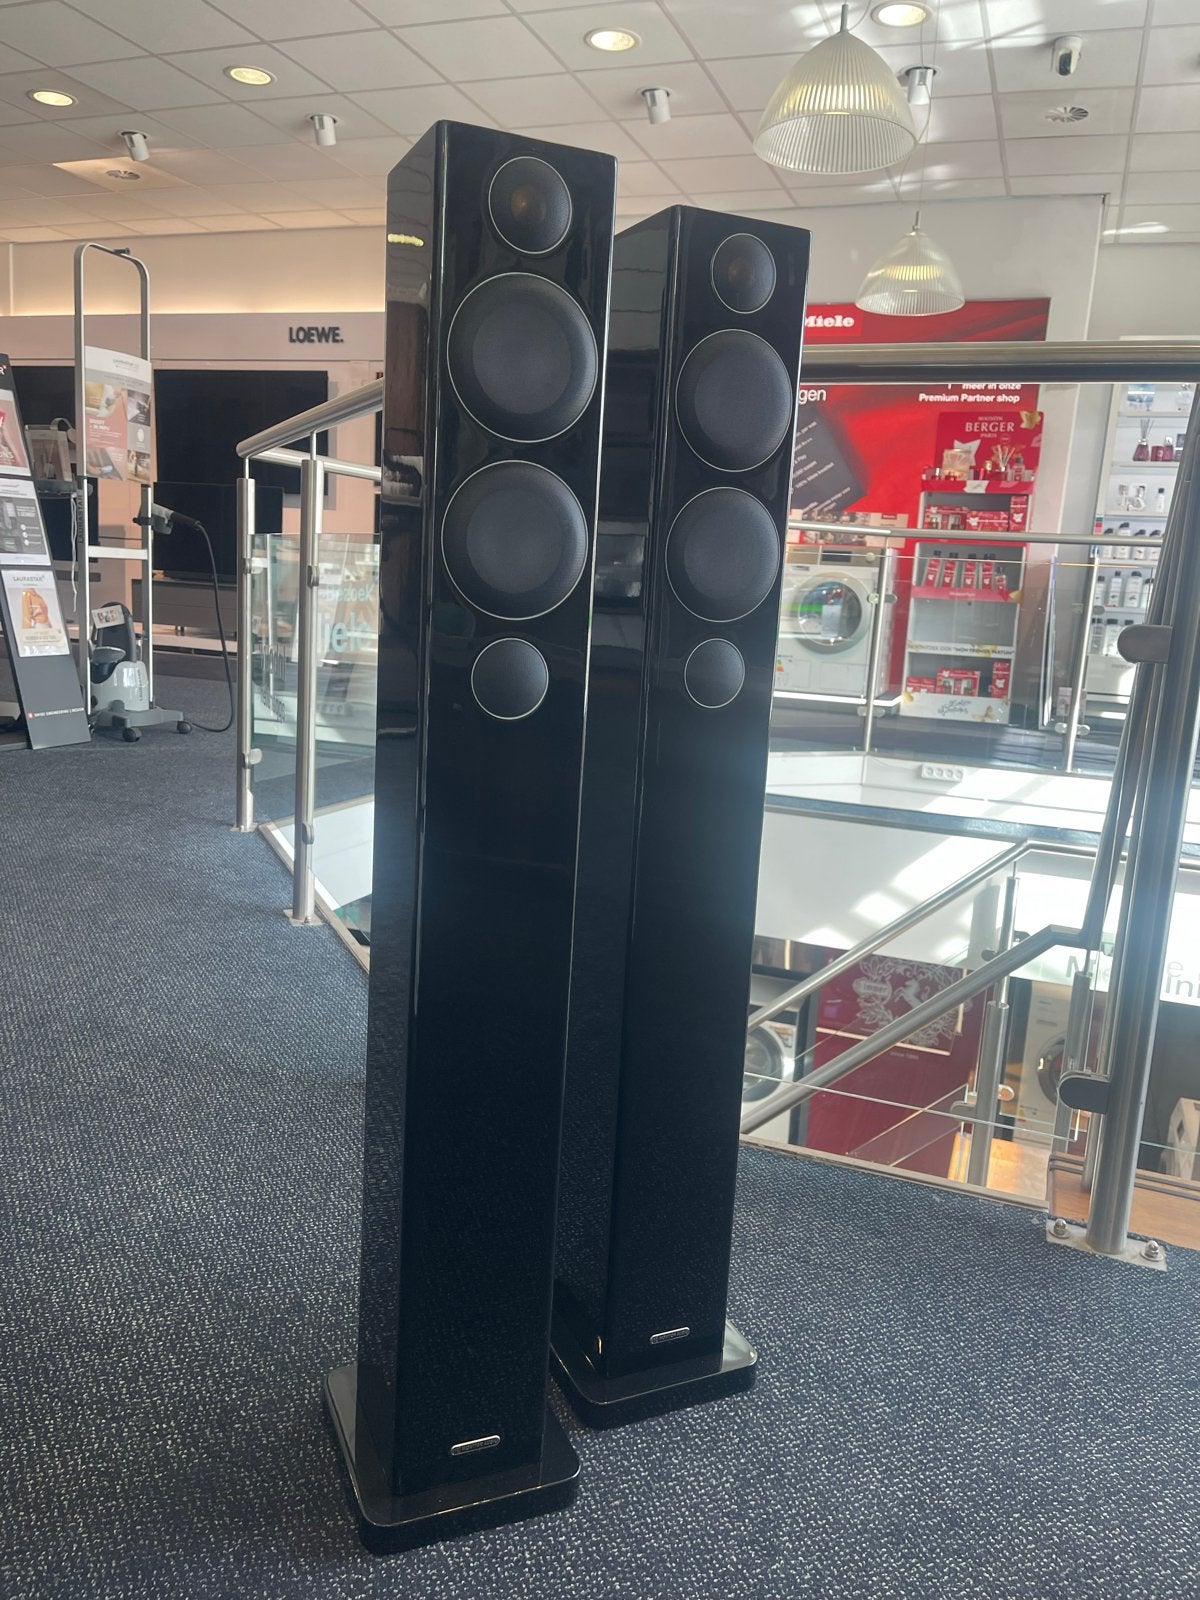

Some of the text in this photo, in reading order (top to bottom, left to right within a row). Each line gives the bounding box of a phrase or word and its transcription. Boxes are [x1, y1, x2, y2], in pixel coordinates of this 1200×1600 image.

[288, 326, 344, 343] LOEWE.
[919, 393, 1020, 405] Premium Partner shop
[965, 422, 1015, 432] BERGER
